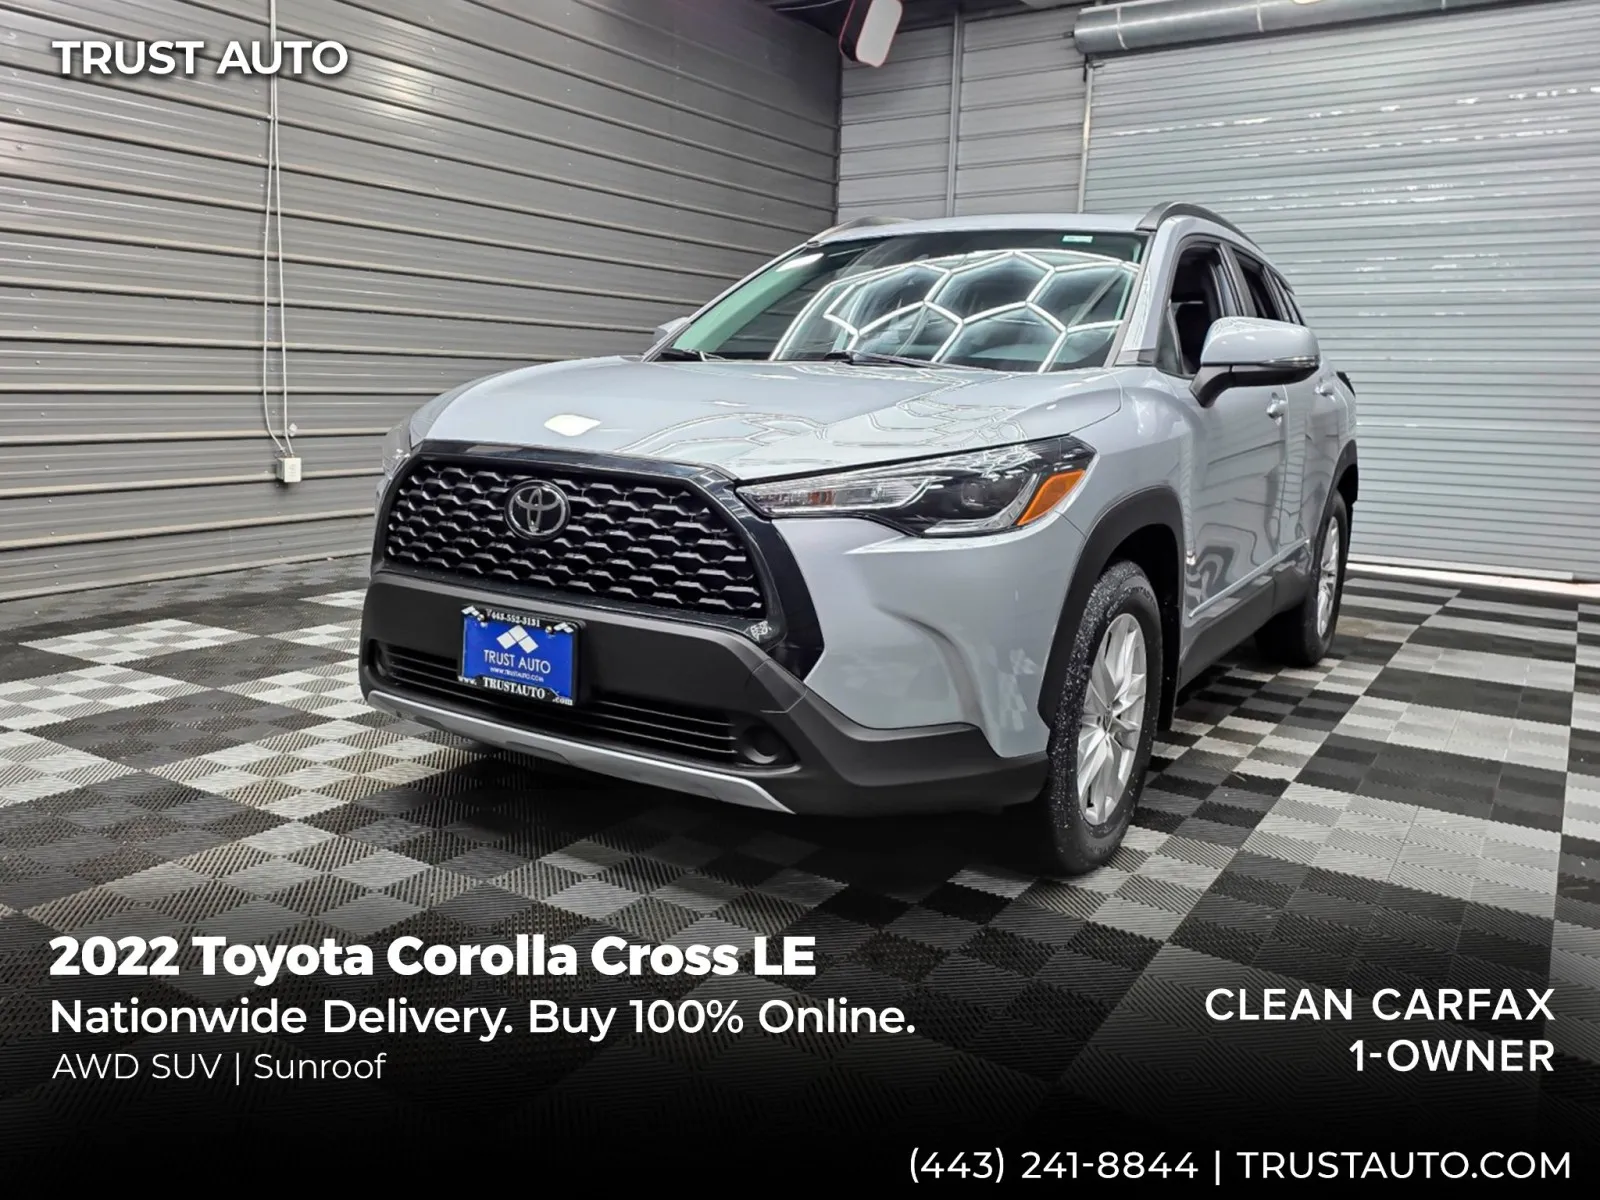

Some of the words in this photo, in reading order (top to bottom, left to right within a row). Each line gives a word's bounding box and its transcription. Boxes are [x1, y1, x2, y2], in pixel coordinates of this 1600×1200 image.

[484, 649, 515, 667] TRUST
[518, 657, 551, 674] AUTO
[482, 677, 546, 699] TRUSTAUTO
